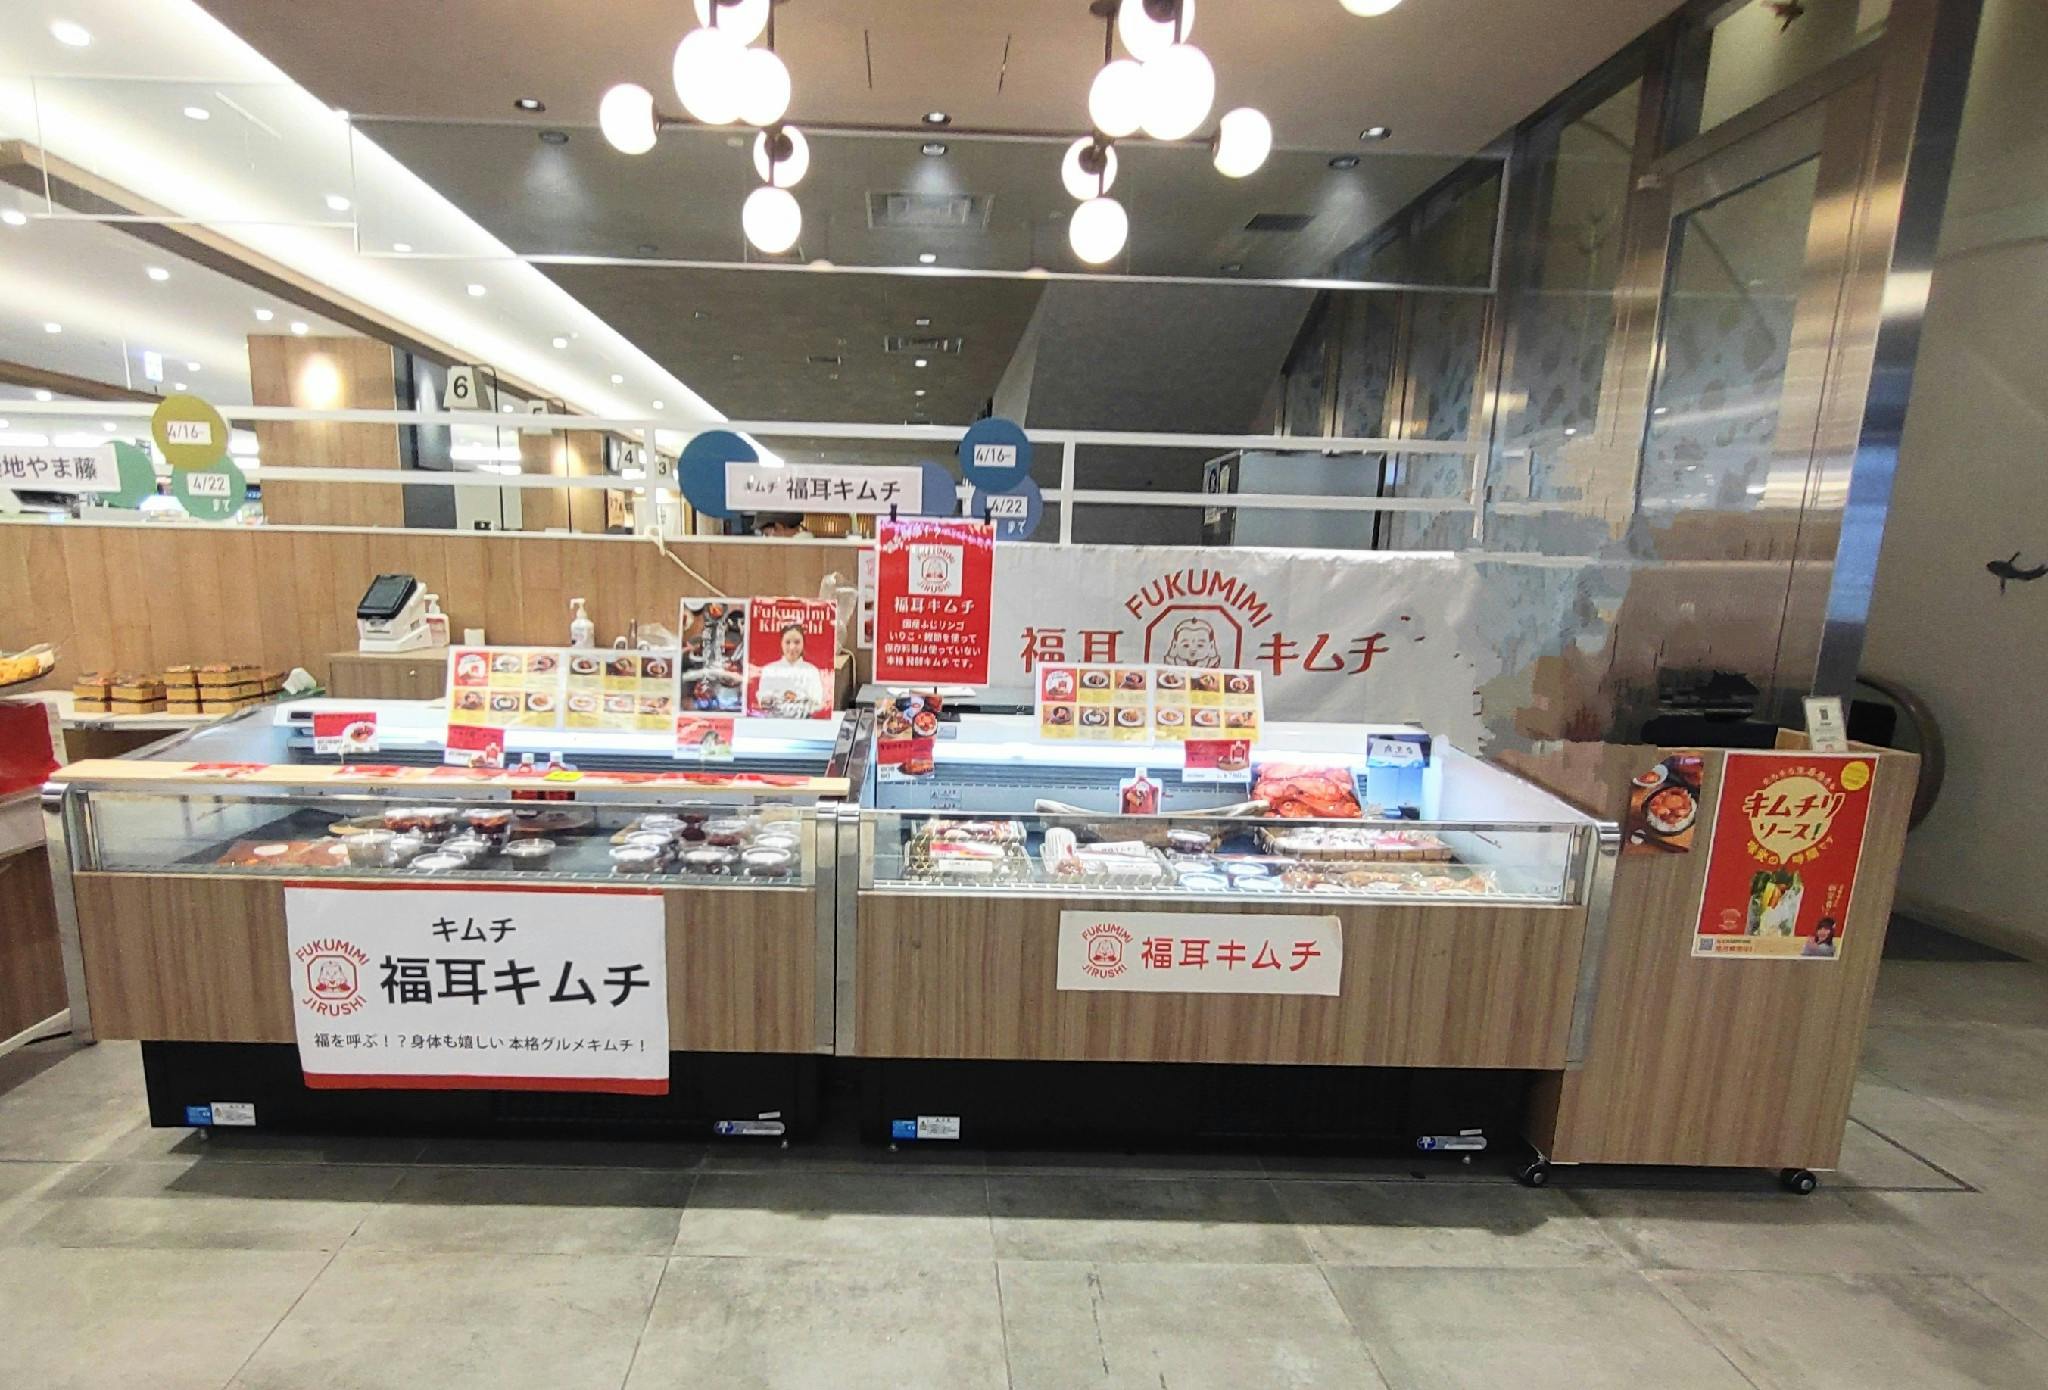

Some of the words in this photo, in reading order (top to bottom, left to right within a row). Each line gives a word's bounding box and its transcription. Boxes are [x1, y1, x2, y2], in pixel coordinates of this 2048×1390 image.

[453, 374, 468, 399] 6
[0, 456, 98, 480] 地やま藤
[624, 451, 634, 464] 4
[658, 460, 667, 476] 3
[192, 476, 226, 491] 4/22
[786, 477, 900, 502] 福耳キムチ
[990, 498, 1023, 514] 4/22
[1125, 568, 1273, 629] FUKUMIMI
[1256, 631, 1391, 676] キムチ
[1744, 792, 1845, 819] キムチリ
[432, 917, 516, 943] キムチ
[1081, 923, 1133, 944] FUKUMIMI
[295, 938, 370, 966] FUKUMIMI
[1141, 936, 1321, 972] 福耳キムチ
[379, 955, 650, 1006] 福耳キムチ
[1081, 964, 1128, 979] JIRUSHI
[302, 995, 367, 1017] JIRUSHI
